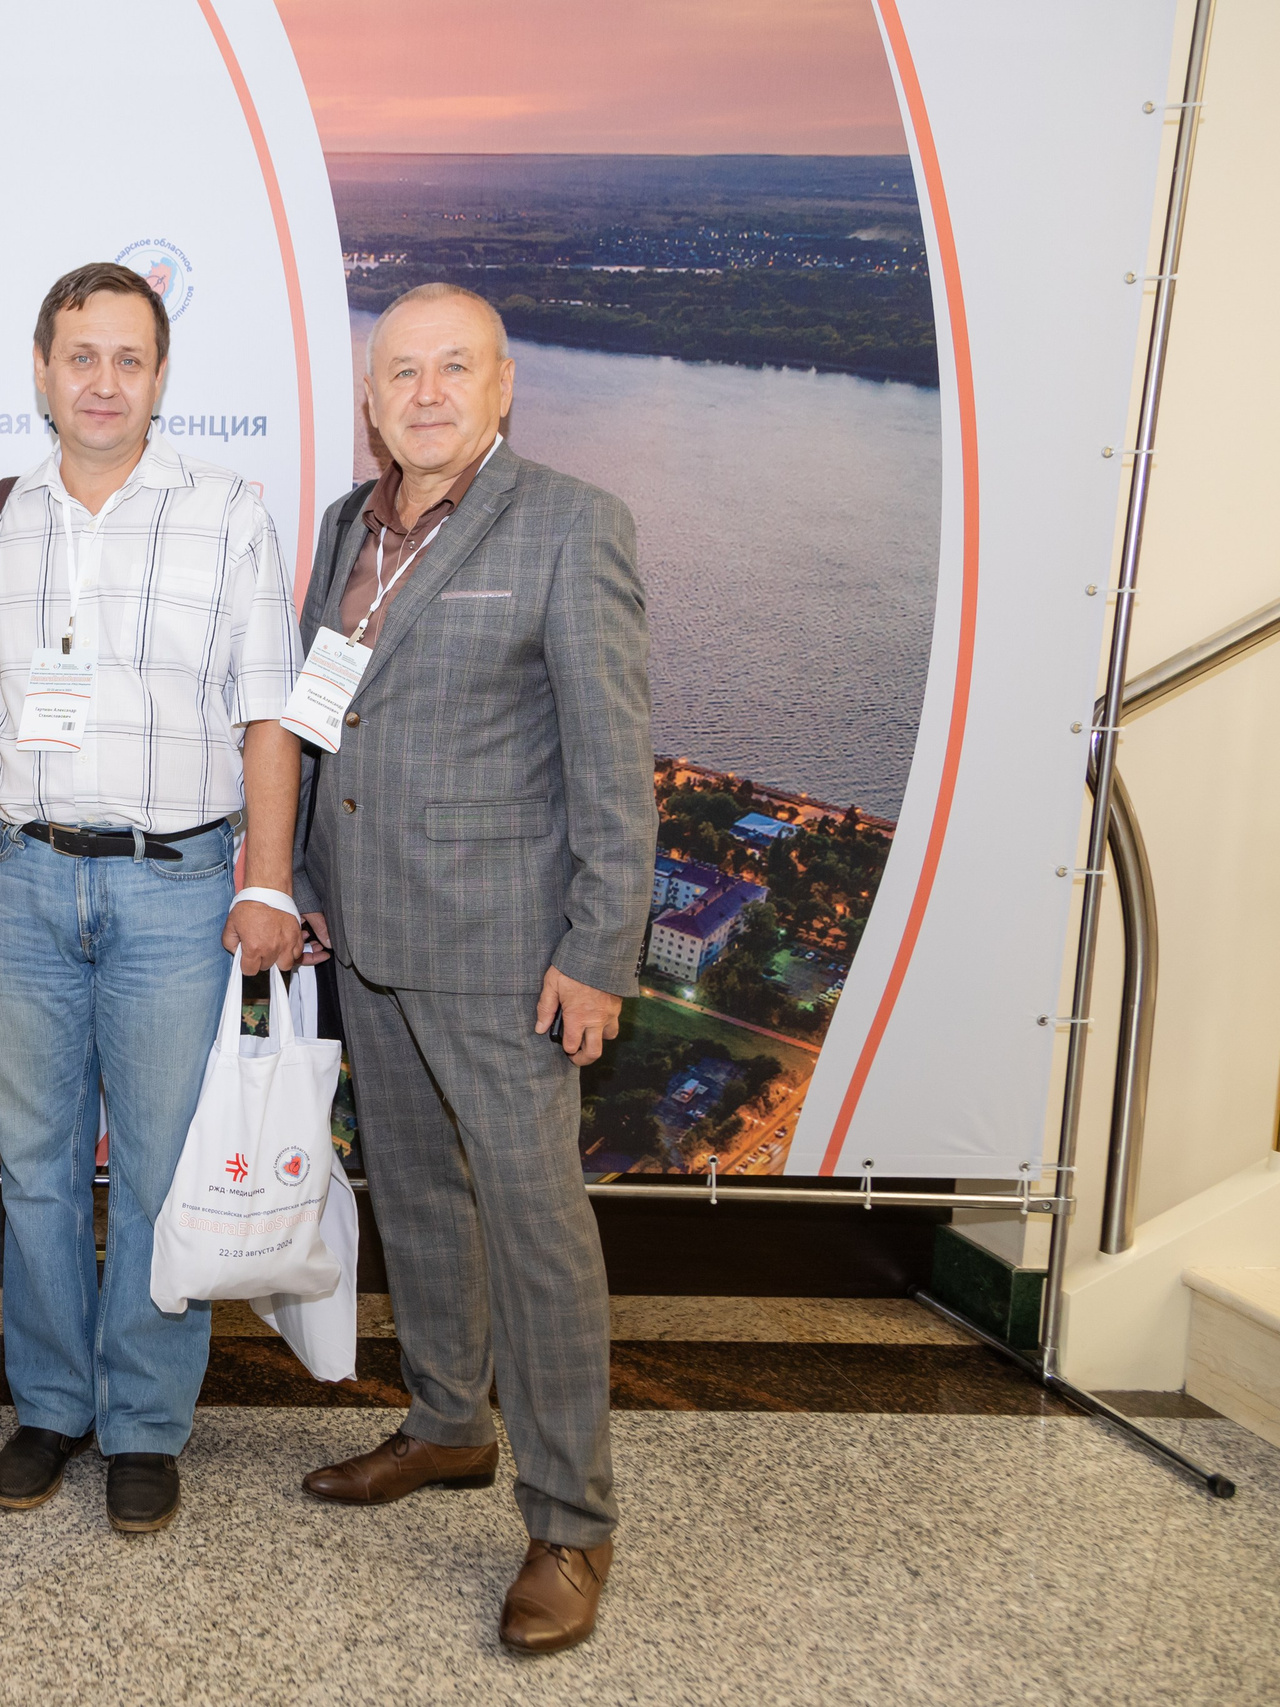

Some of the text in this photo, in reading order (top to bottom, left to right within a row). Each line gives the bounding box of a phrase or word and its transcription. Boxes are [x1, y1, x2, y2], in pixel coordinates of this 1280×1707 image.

[153, 237, 193, 273] областное
[182, 1202, 201, 1212] Вторая
[201, 1206, 243, 1218] всероссийская
[219, 1238, 293, 1258] 22-23 августа 2024
